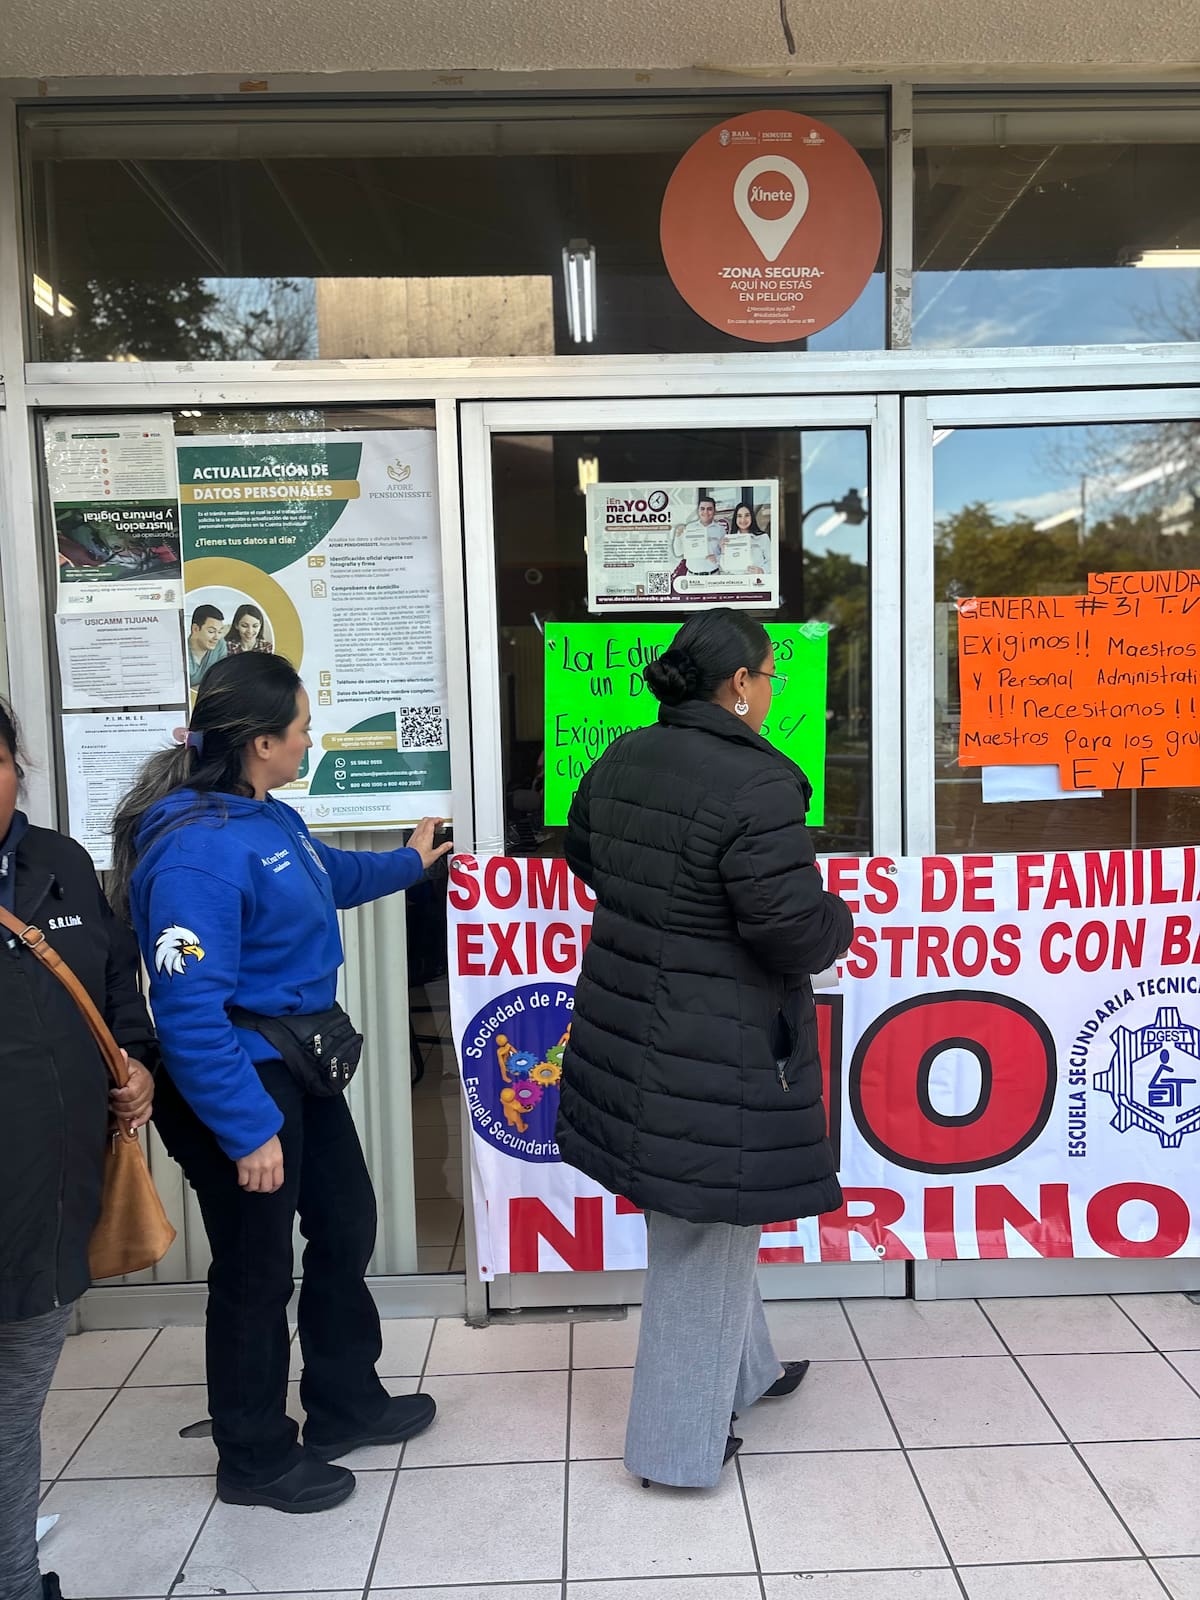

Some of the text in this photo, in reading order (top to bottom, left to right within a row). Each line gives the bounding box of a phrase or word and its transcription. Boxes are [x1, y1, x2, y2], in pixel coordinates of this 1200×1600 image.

[730, 279, 812, 291] AQUÍ NO ESTÁS
[739, 293, 804, 301] EN PELIGRO
[193, 463, 328, 480] ACTUALIZACIÓN DE
[193, 485, 332, 500] DATOS PERSONALES
[606, 496, 620, 505] ¡En
[83, 508, 173, 522] y Pintura Digital
[606, 512, 671, 524] DECLARO!
[116, 522, 174, 532] Ilustración
[194, 536, 296, 548] ¿Tienes tus datos al día?
[960, 598, 1064, 620] GENERAL
[85, 616, 160, 626] USICAMM TIJUANA
[1108, 637, 1197, 657] Maestros
[590, 677, 612, 697] un
[998, 668, 1073, 690] Personal
[964, 727, 1049, 747] Maestros
[1124, 733, 1153, 749] los
[1073, 758, 1098, 788] E
[1140, 756, 1160, 786] F
[921, 856, 995, 914] DE
[1017, 846, 1200, 912] FAMILI
[836, 924, 1022, 978] STROS
[1039, 918, 1147, 976] CON
[466, 996, 526, 1060] Sociedad
[530, 992, 550, 1008] de
[1146, 1030, 1188, 1042] DGEST
[1068, 976, 1200, 1158] ESCUELA SECUNDARIA TECNIC
[466, 1076, 560, 1156] Escuela Secundaria
